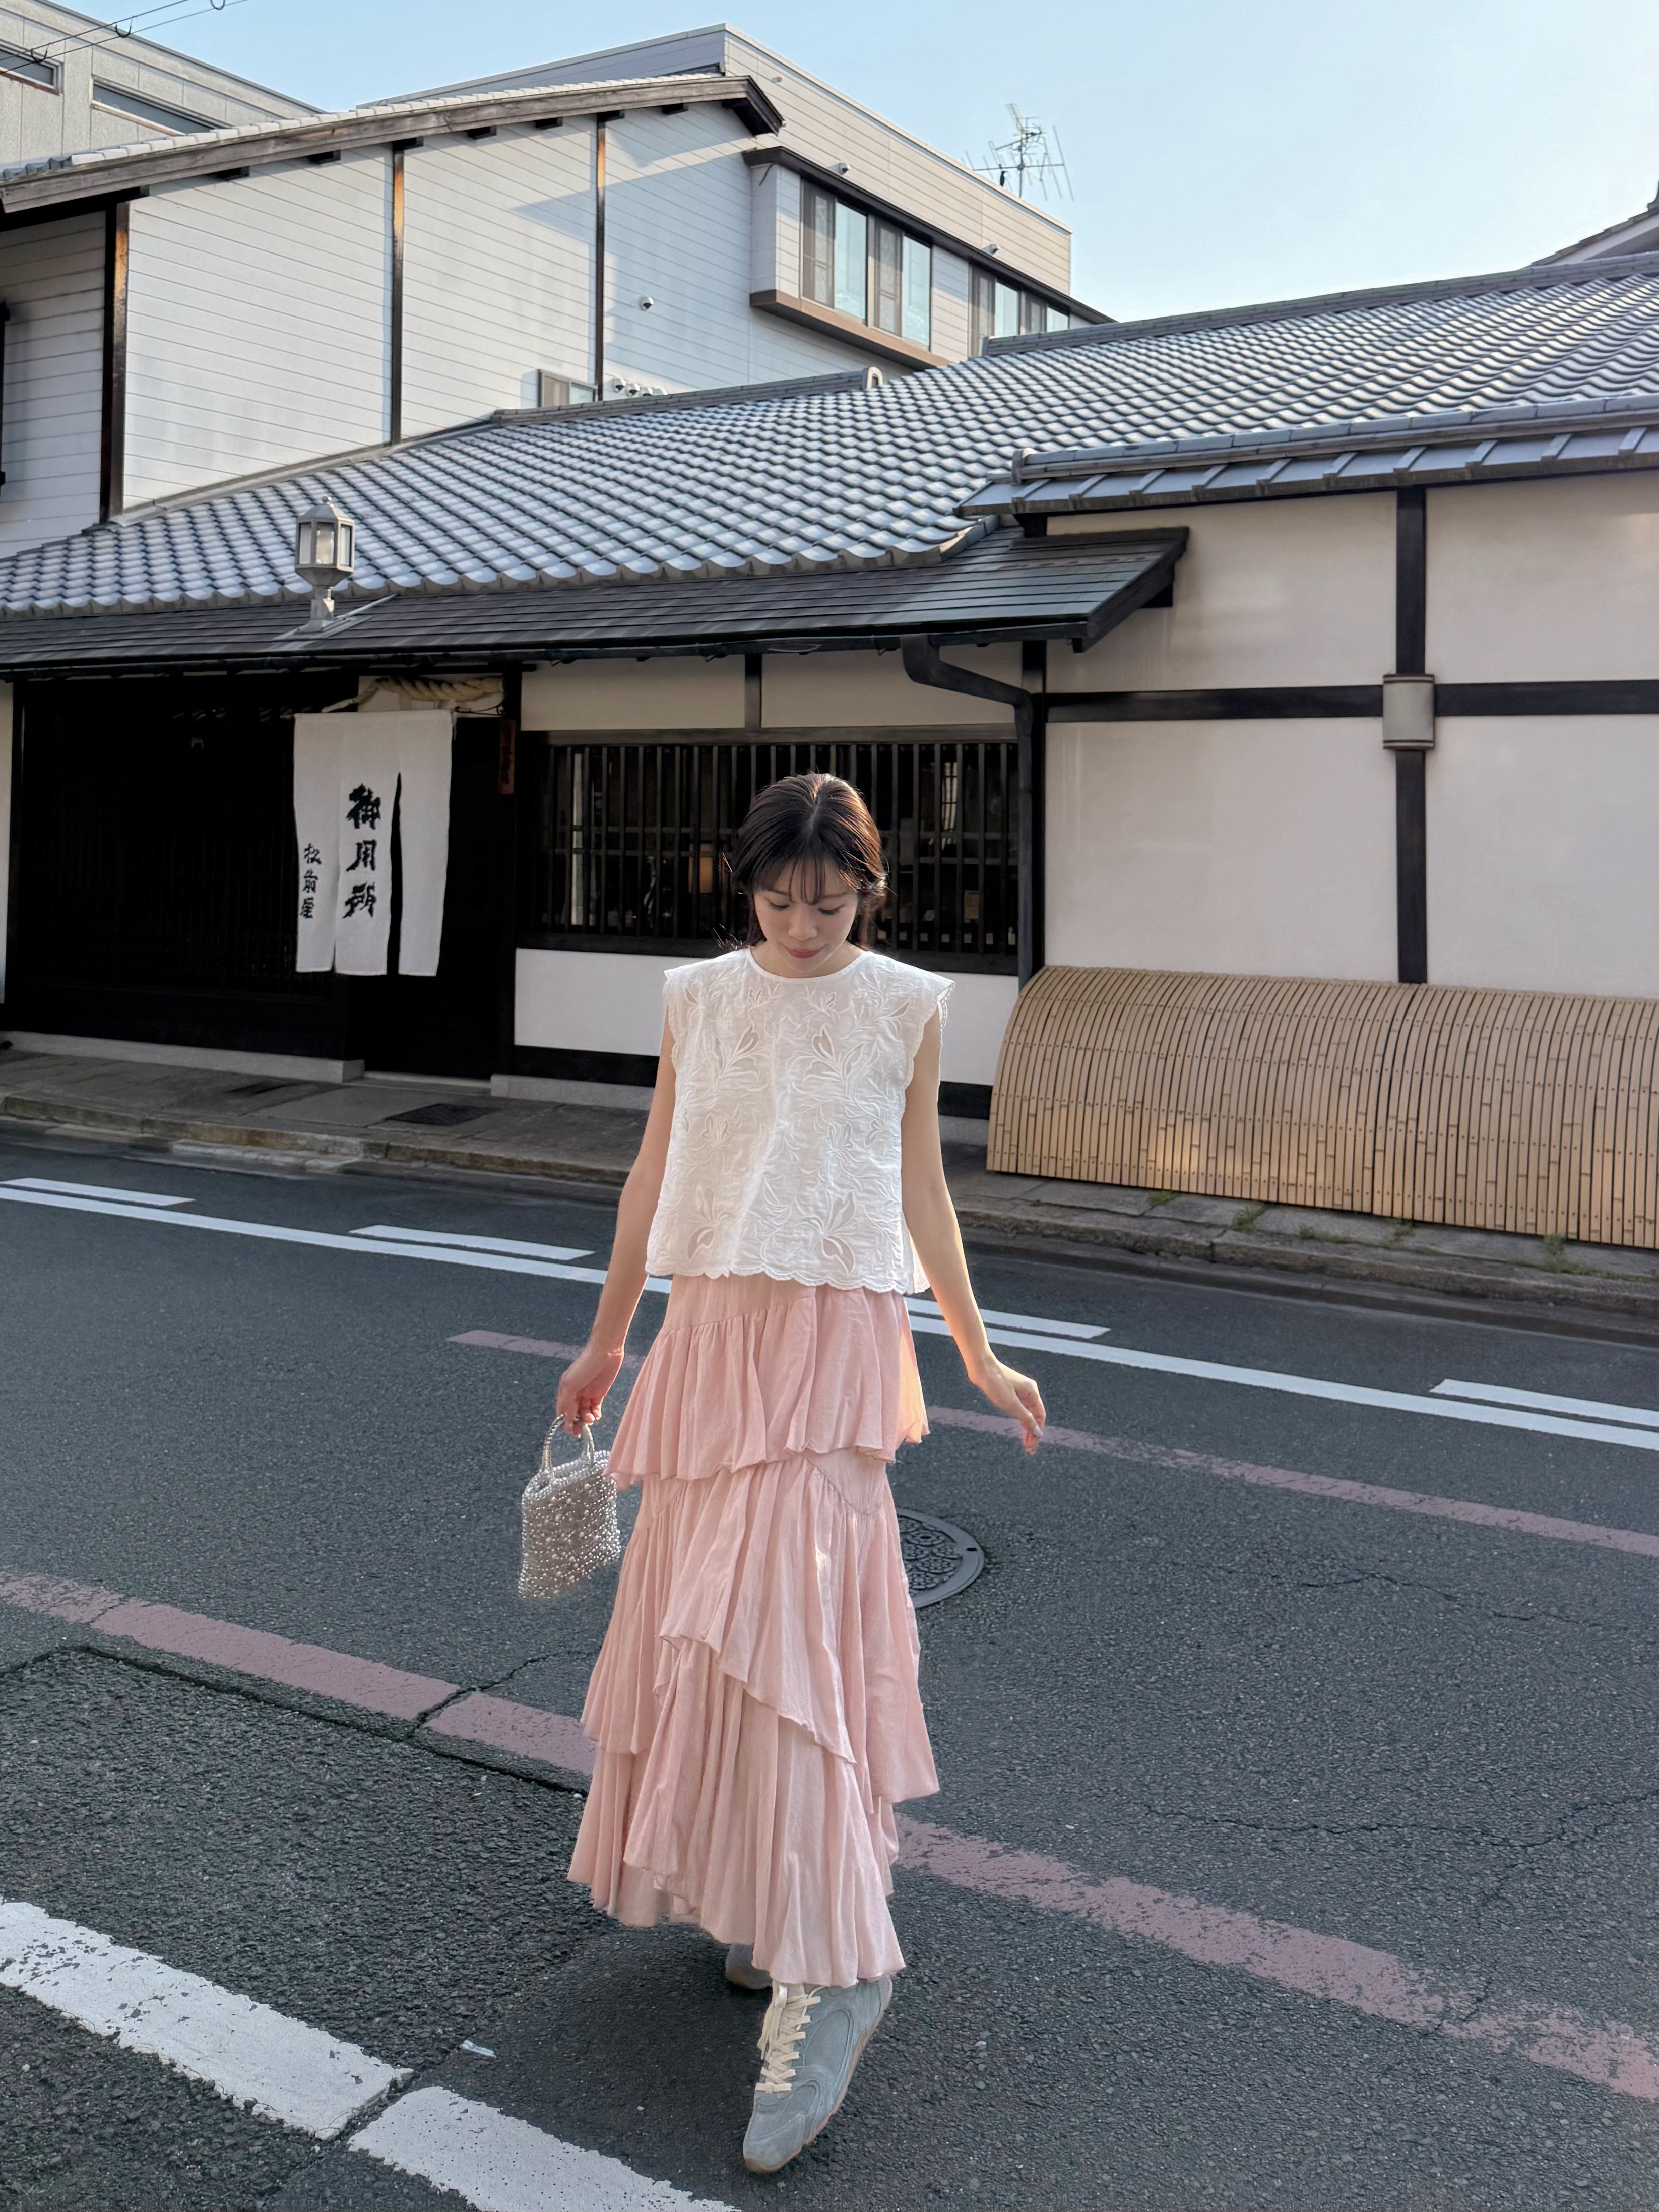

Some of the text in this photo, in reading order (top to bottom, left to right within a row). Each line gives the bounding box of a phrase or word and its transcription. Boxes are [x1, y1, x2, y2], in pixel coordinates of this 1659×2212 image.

[300, 843, 322, 919] 松前屋
[342, 783, 381, 919] 御用所
